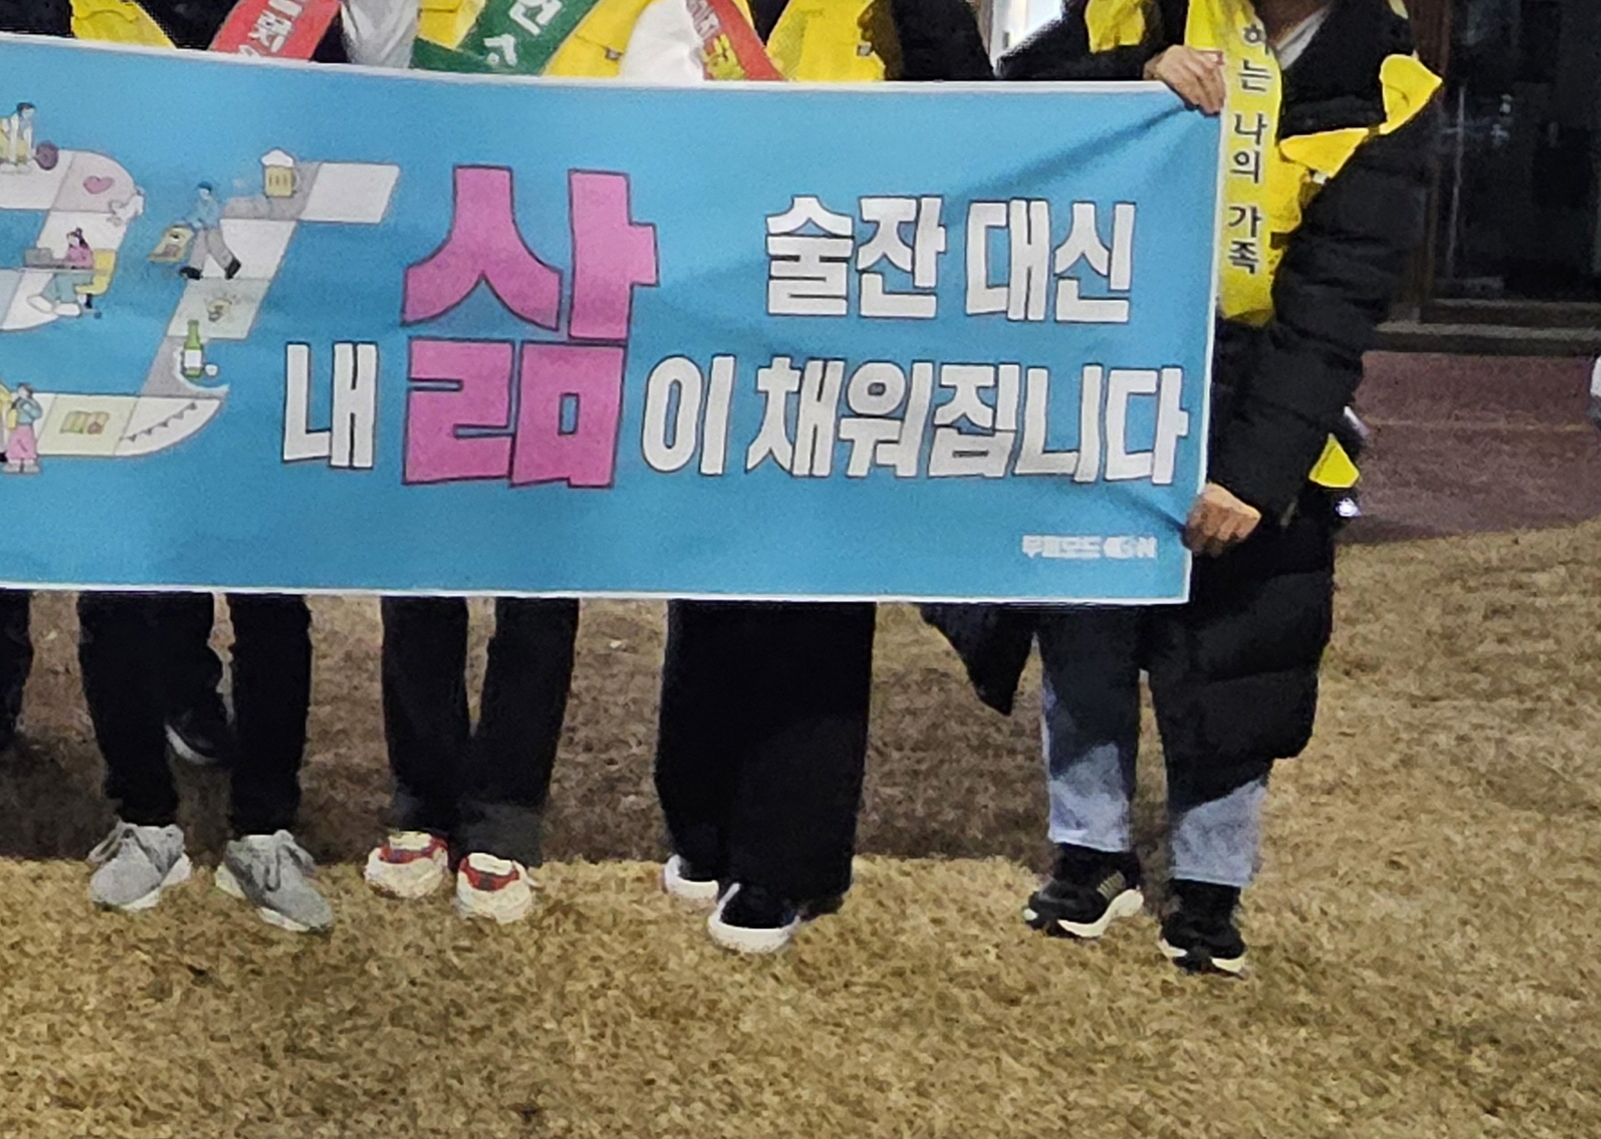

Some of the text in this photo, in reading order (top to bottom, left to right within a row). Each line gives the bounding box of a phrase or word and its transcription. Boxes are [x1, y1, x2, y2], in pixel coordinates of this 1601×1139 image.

[1230, 112, 1267, 184] 나의
[764, 194, 1137, 323] 술잔 대신
[1228, 206, 1262, 275] 가족
[282, 341, 379, 470] 내
[746, 354, 1189, 486] 채워집니다
